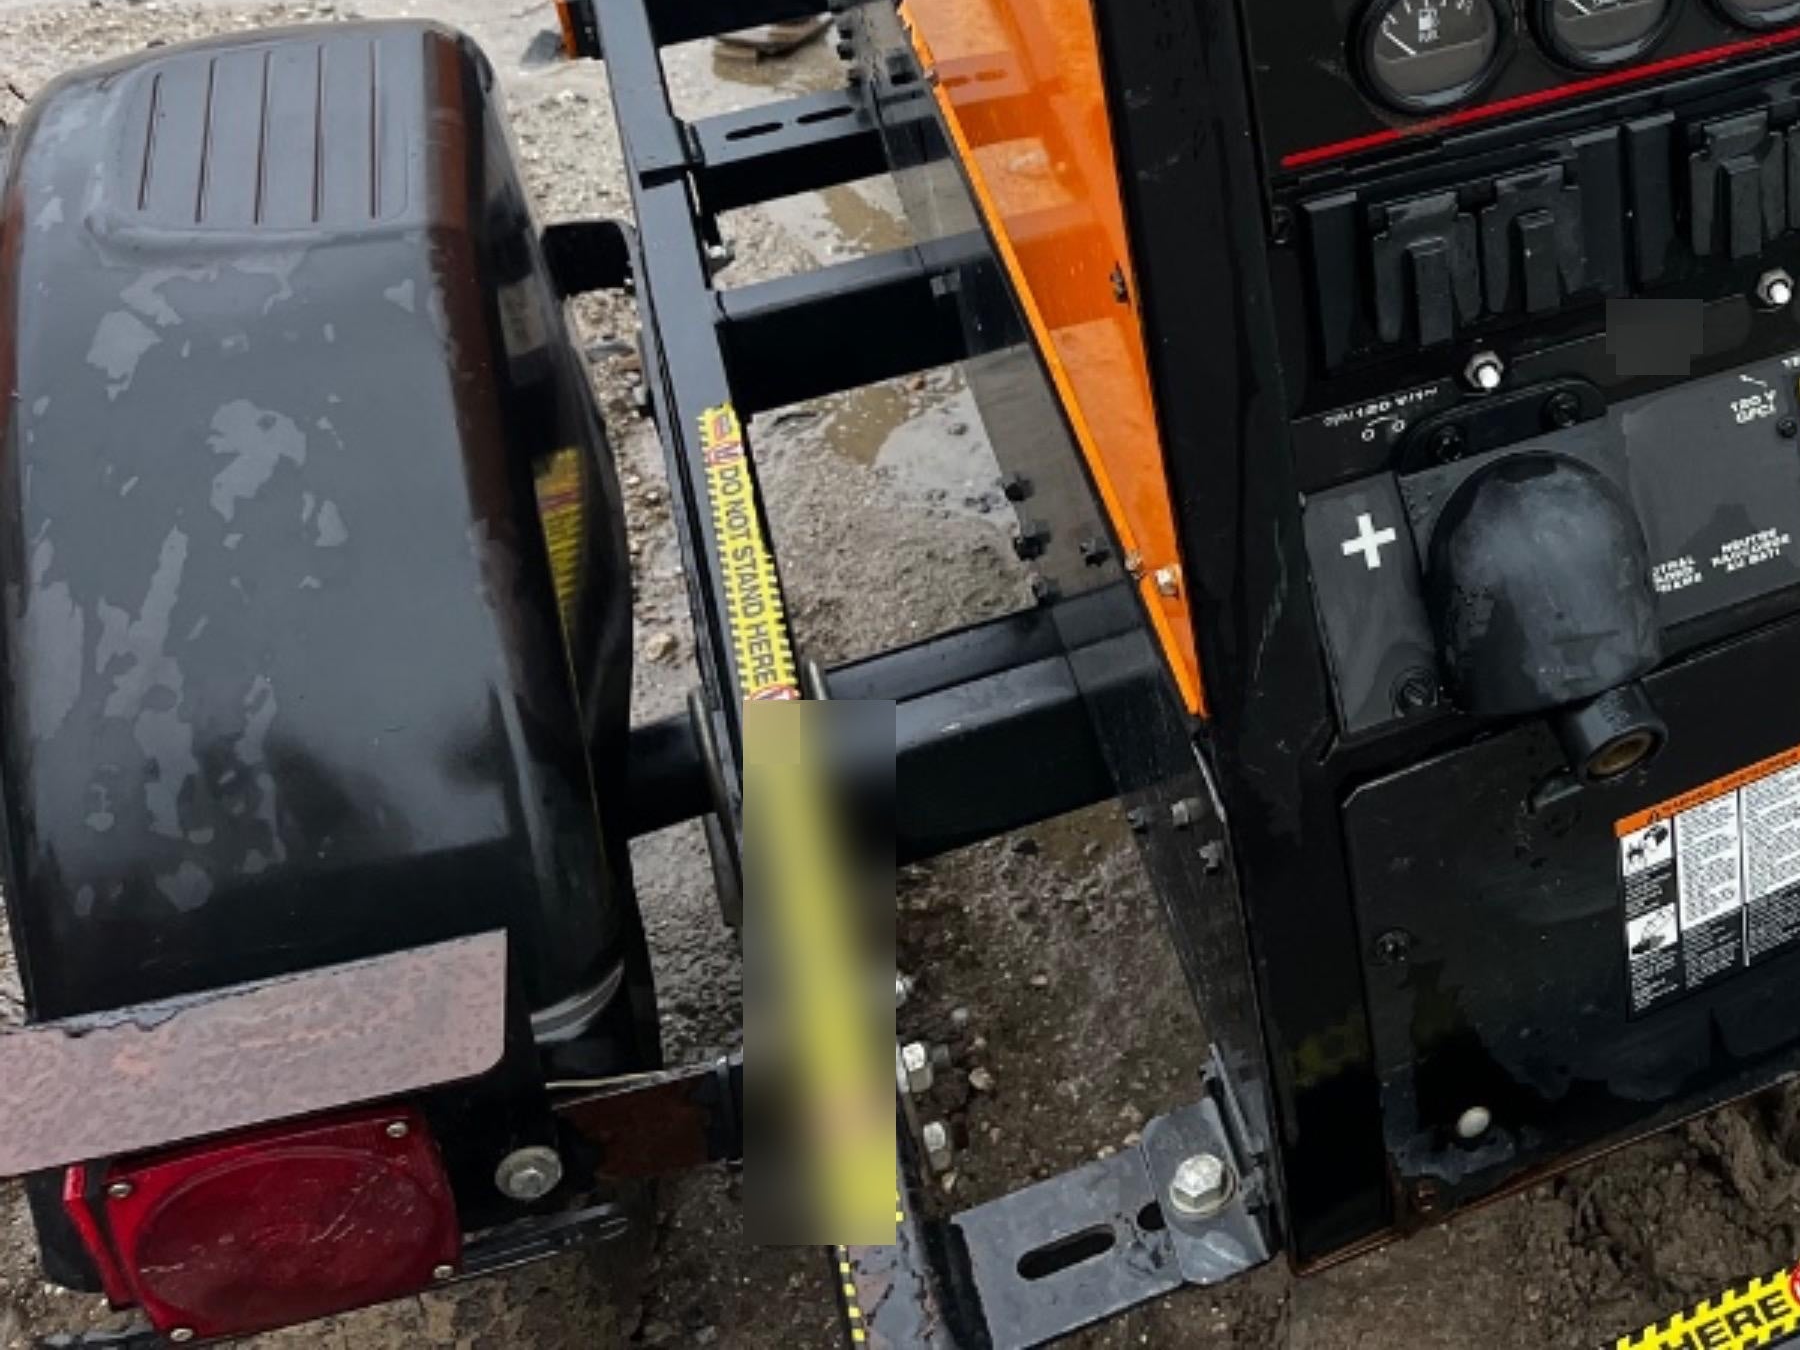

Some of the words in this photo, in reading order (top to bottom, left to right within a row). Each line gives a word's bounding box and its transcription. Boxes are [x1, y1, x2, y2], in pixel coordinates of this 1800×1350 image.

[719, 466, 743, 497] DO
[724, 500, 751, 542] NOT
[731, 545, 766, 618] STAND
[745, 621, 779, 686] HERE
[1677, 1292, 1788, 1350] HERE
